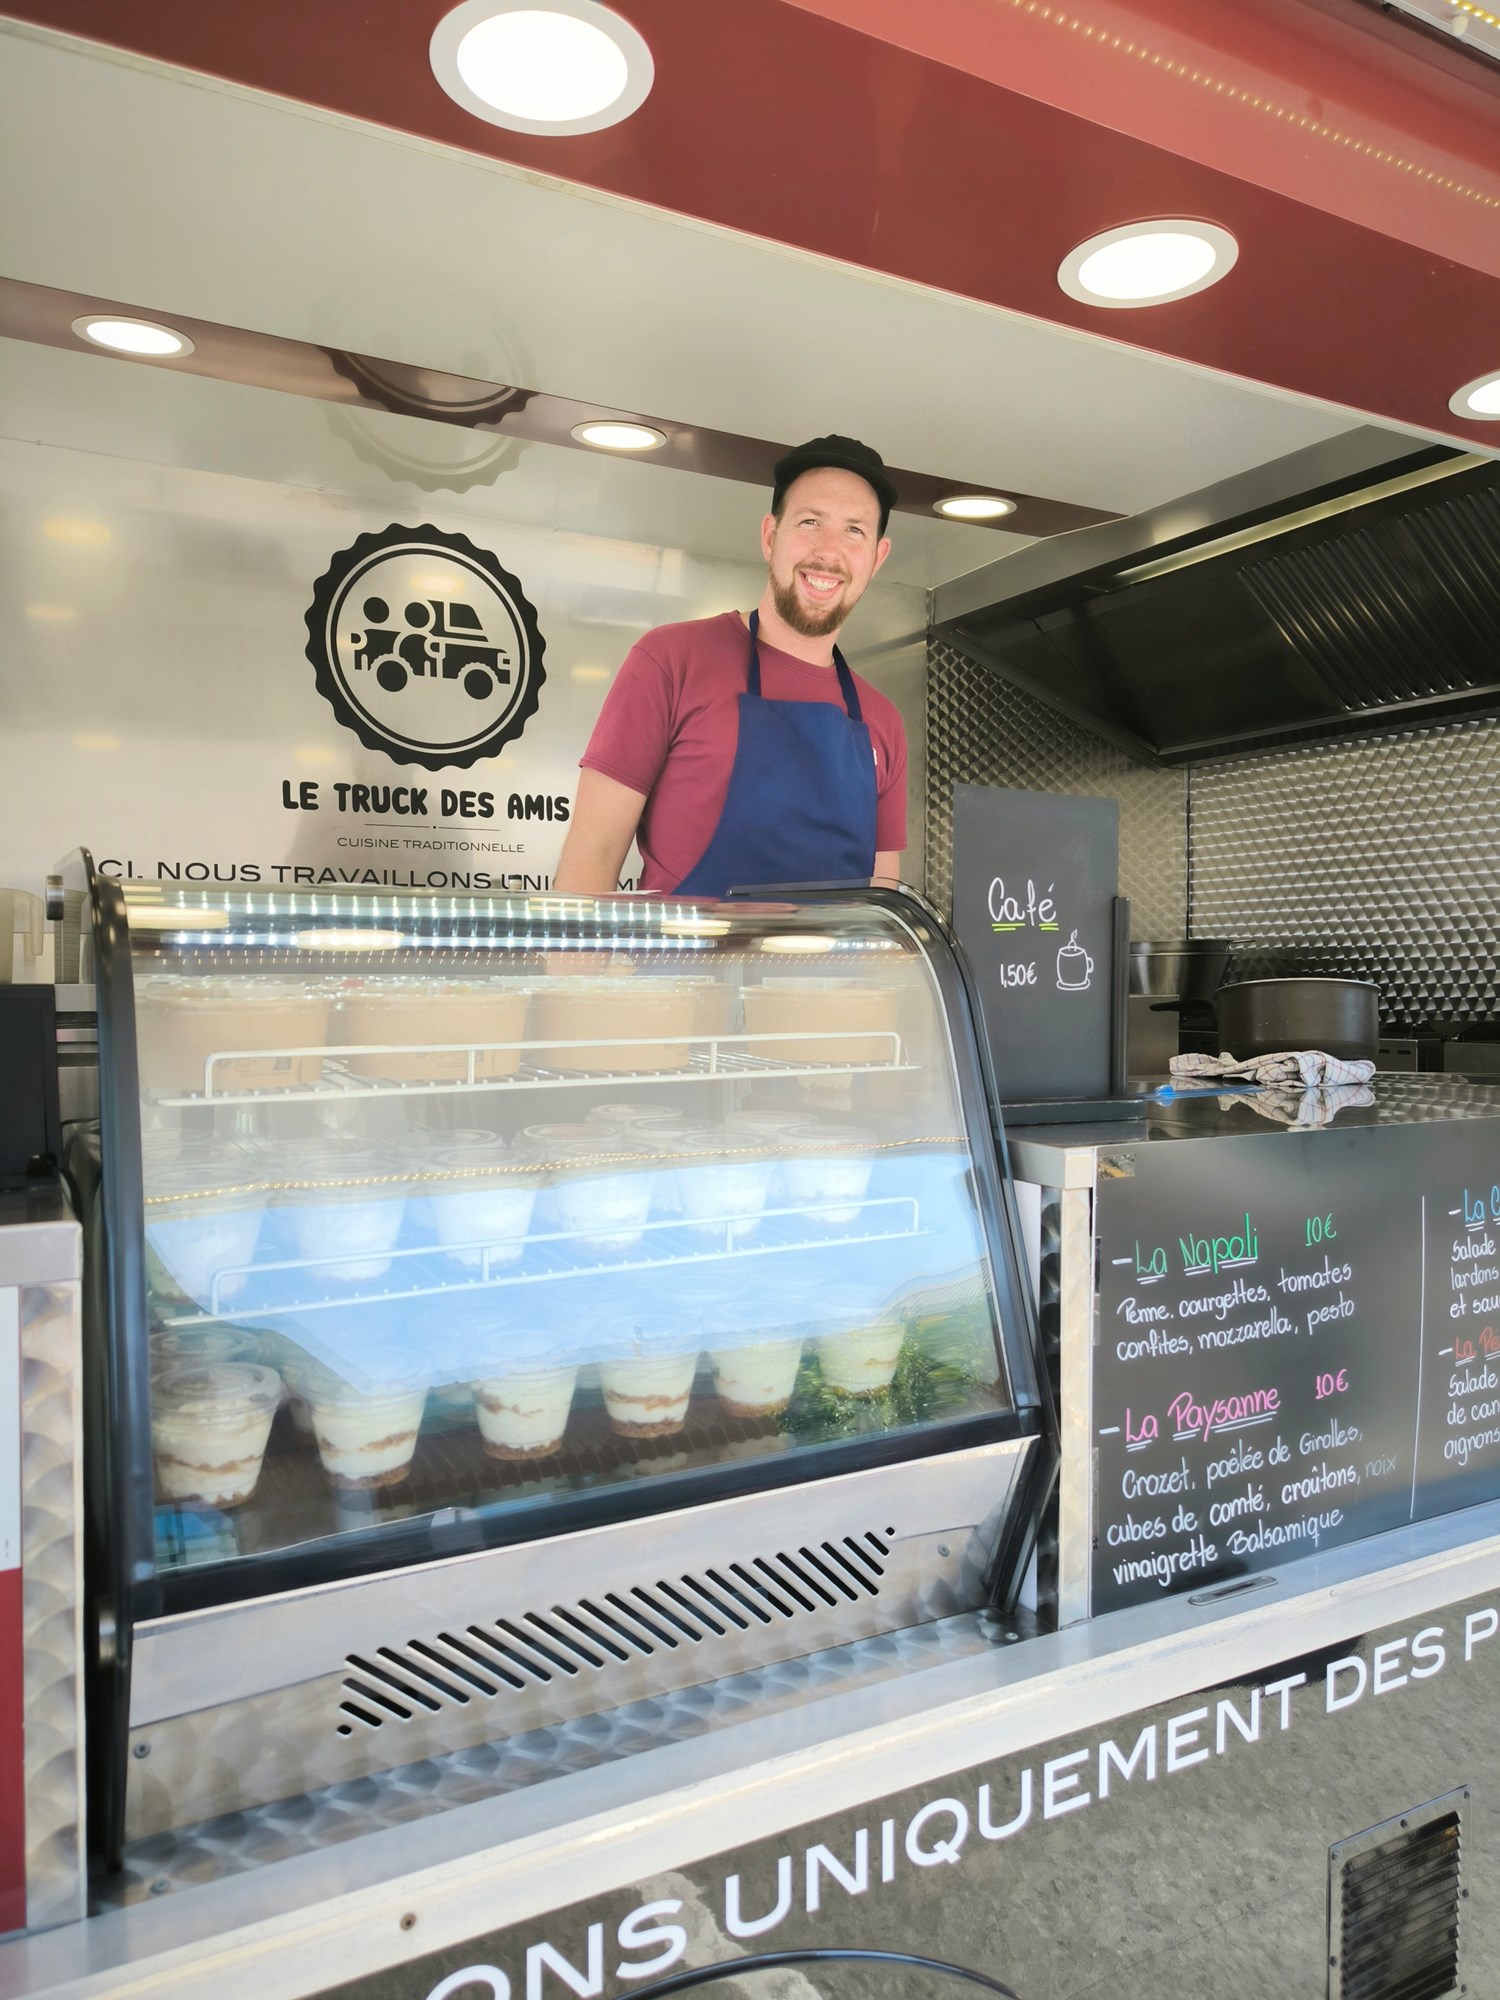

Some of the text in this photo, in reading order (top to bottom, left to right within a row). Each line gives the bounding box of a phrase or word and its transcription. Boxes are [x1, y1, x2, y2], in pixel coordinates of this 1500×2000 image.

[282, 780, 570, 822] LE TRUCK DES AMIS
[337, 837, 525, 853] CUISINE TRADITIONNELLE
[158, 862, 261, 882] NOUS
[271, 865, 492, 889] TRAVAILLONS
[988, 877, 1057, 926] Café
[1000, 961, 1038, 988] 1,50€
[1179, 1213, 1259, 1274] Napoli
[1305, 1213, 1337, 1246] 10€
[1451, 1232, 1496, 1262] Salade
[1277, 1255, 1352, 1293] tomates
[1450, 1262, 1499, 1291] lardons
[1449, 1293, 1467, 1318] et
[1116, 1291, 1355, 1361] confites, mozzarella, pesto
[1448, 1364, 1498, 1397] Salade
[1167, 1388, 1281, 1442] Paysanne
[1315, 1369, 1349, 1399] 10€
[1447, 1402, 1466, 1425] de
[1206, 1439, 1264, 1489] poêlée
[1268, 1436, 1291, 1466] de
[1299, 1418, 1363, 1455] Girolles,
[1444, 1427, 1500, 1466] oignons
[1106, 1513, 1167, 1546] cubes
[1171, 1504, 1198, 1534] de
[1209, 1483, 1270, 1526] comté,
[1364, 1454, 1398, 1478] noix
[1112, 1507, 1344, 1588] vinaigrette Balsamique
[724, 1672, 1307, 1938] UNIQUEMENT
[1326, 1626, 1446, 1714] DES
